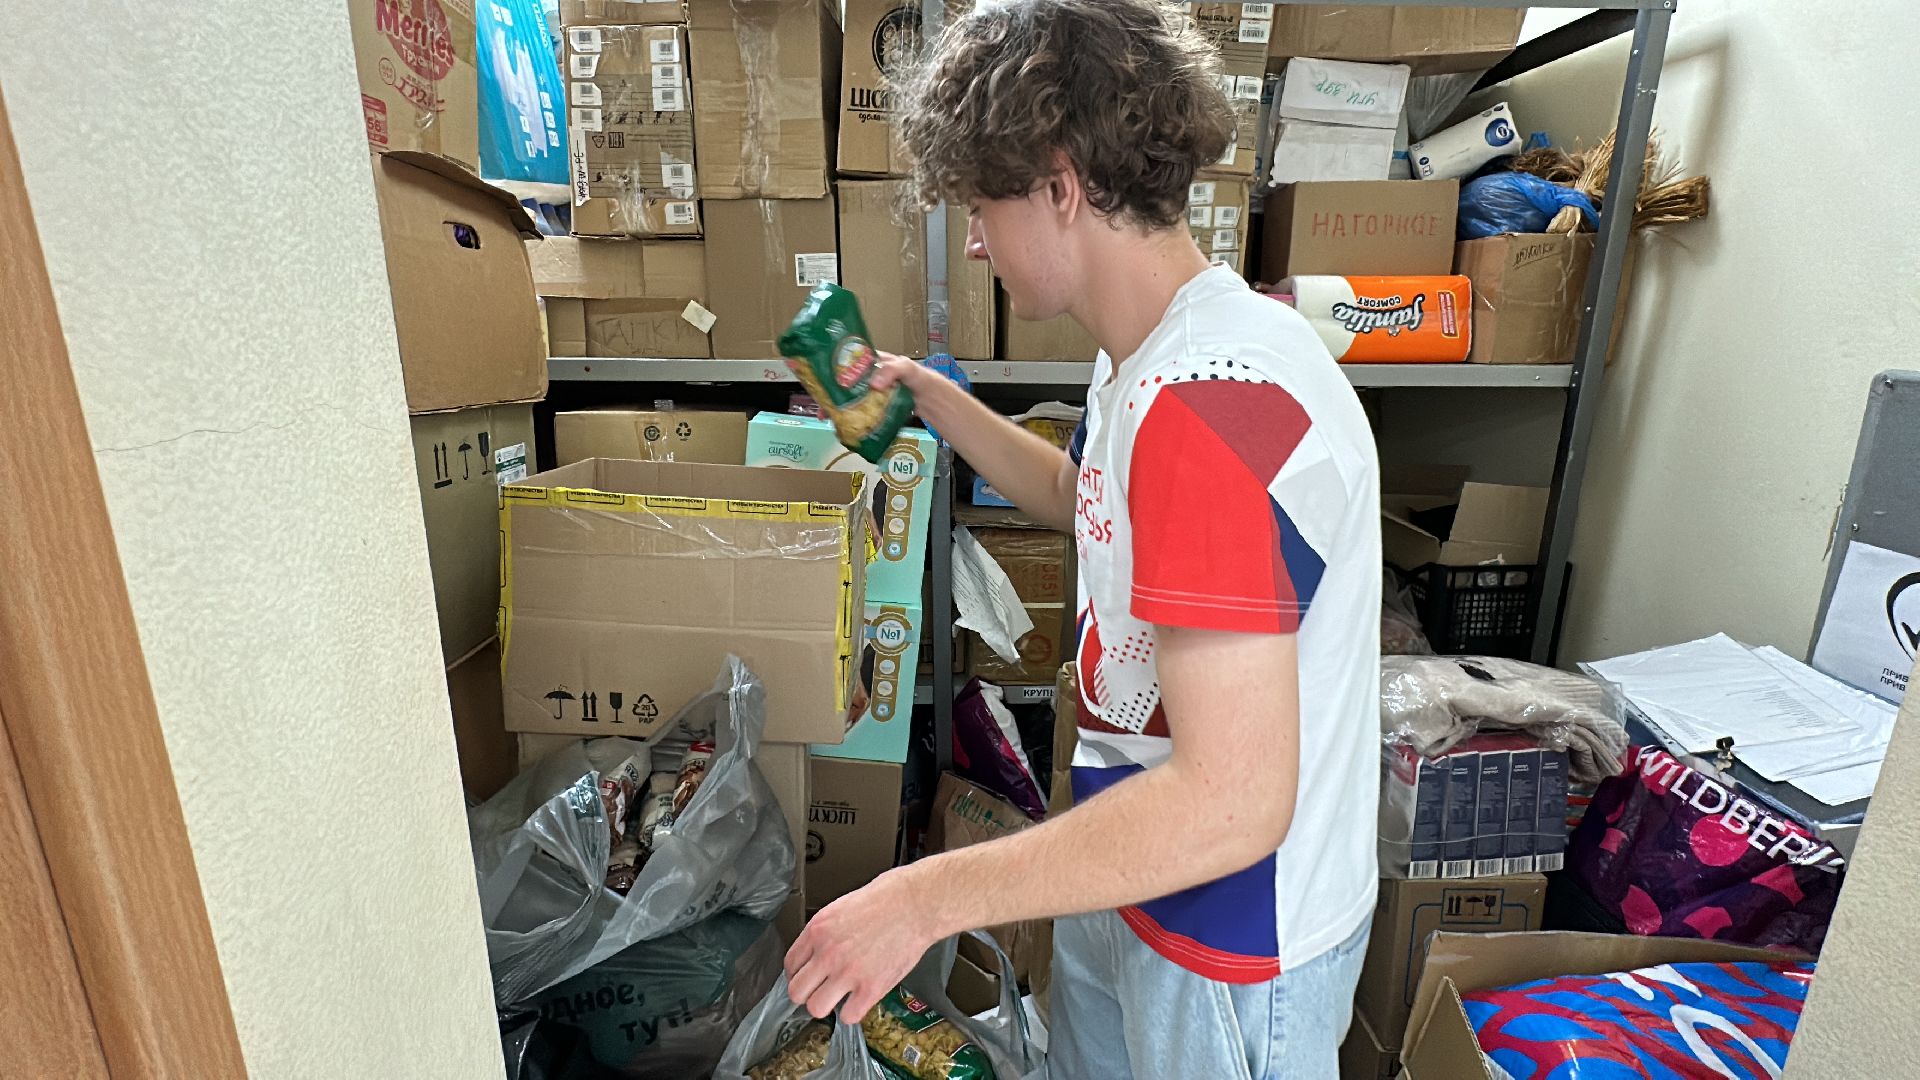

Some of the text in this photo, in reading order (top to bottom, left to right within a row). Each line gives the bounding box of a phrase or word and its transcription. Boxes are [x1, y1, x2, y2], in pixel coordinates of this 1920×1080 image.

[1332, 293, 1426, 334] familia
[1356, 296, 1401, 308] COMFORT
[1880, 675, 1906, 692] ПРИВ
[618, 997, 693, 1046] тут!
